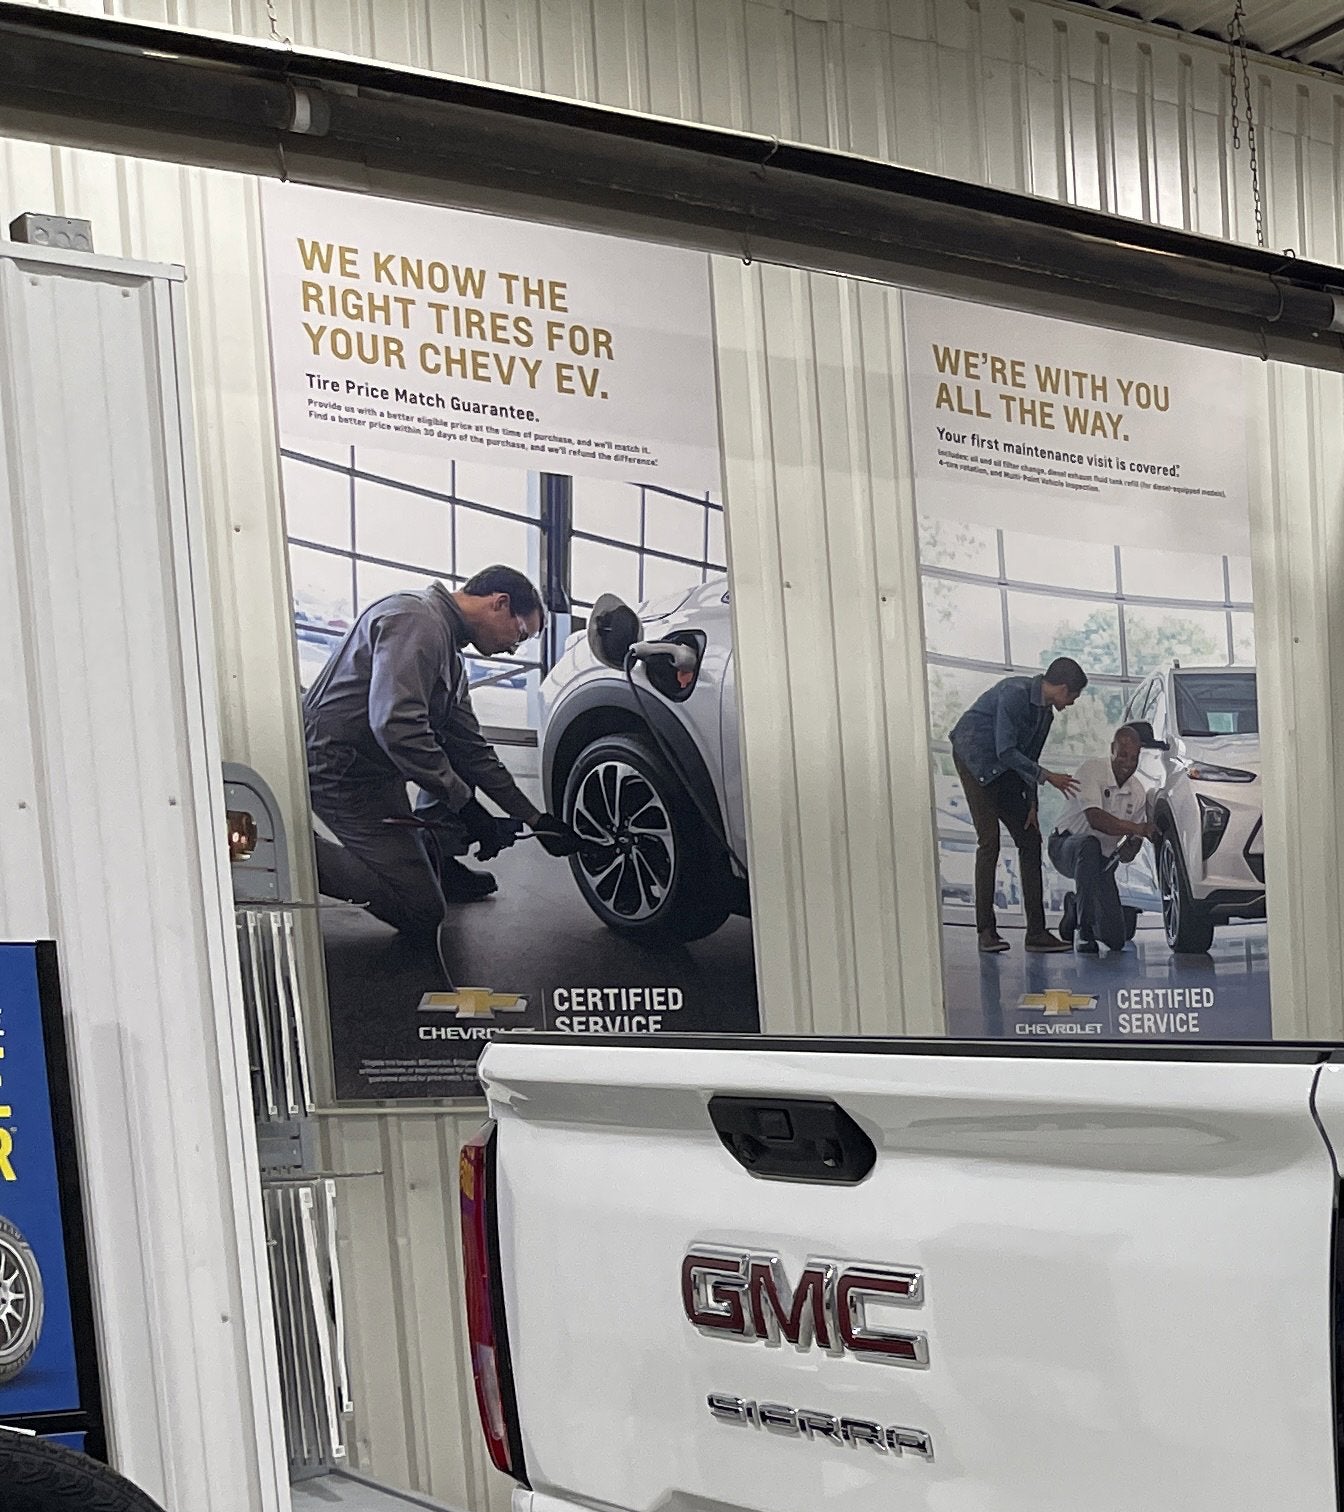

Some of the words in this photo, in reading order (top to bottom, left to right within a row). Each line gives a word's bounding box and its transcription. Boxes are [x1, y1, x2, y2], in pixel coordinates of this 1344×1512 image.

[297, 238, 360, 279] WE
[373, 251, 486, 300] KNOW
[498, 272, 568, 313] THE
[301, 280, 416, 329] RIGHT
[427, 301, 533, 348] TIRES
[547, 320, 614, 360] FOR
[302, 322, 406, 370] YOUR
[419, 343, 542, 389] CHEVY
[556, 362, 609, 400] EV.
[932, 343, 1026, 389] WE'RE
[1035, 364, 1108, 403] WITH
[1117, 378, 1170, 412] YOU
[306, 373, 340, 392] Tire
[345, 379, 389, 400] Price
[394, 387, 445, 409] Match
[451, 396, 539, 423] Guarantee.
[935, 382, 992, 419] ALL
[999, 394, 1056, 431] THE
[1063, 405, 1130, 442] WAY.
[307, 398, 342, 411] Provide
[357, 407, 377, 417] with
[387, 410, 414, 423] better
[417, 415, 448, 428] eligible
[450, 421, 473, 432] price
[486, 425, 500, 435] the
[502, 427, 521, 438] time
[523, 431, 531, 439] of
[534, 433, 575, 446] purchase,
[577, 439, 591, 447] and
[614, 443, 640, 453] match
[309, 410, 328, 421] Find
[338, 415, 366, 427] better
[369, 421, 391, 432] price
[394, 424, 421, 435] within
[436, 429, 457, 441] days
[459, 434, 468, 442] of
[470, 434, 484, 444] the
[530, 444, 546, 453] and
[568, 449, 596, 459] refund
[598, 452, 612, 461] the
[936, 426, 967, 445] Your
[970, 433, 1000, 451] first
[1003, 442, 1084, 465] maintenance
[1086, 454, 1113, 469] visit
[1116, 457, 1126, 470] is
[553, 987, 683, 1013] CERTIFIED
[555, 1015, 662, 1034] SERVICE
[1117, 987, 1215, 1010] CERTIFIED
[1117, 1012, 1200, 1034] SERVICE
[1015, 1023, 1103, 1035] CHEVROLET
[681, 1241, 930, 1371] GMC
[707, 1391, 935, 1463] SIERRA
